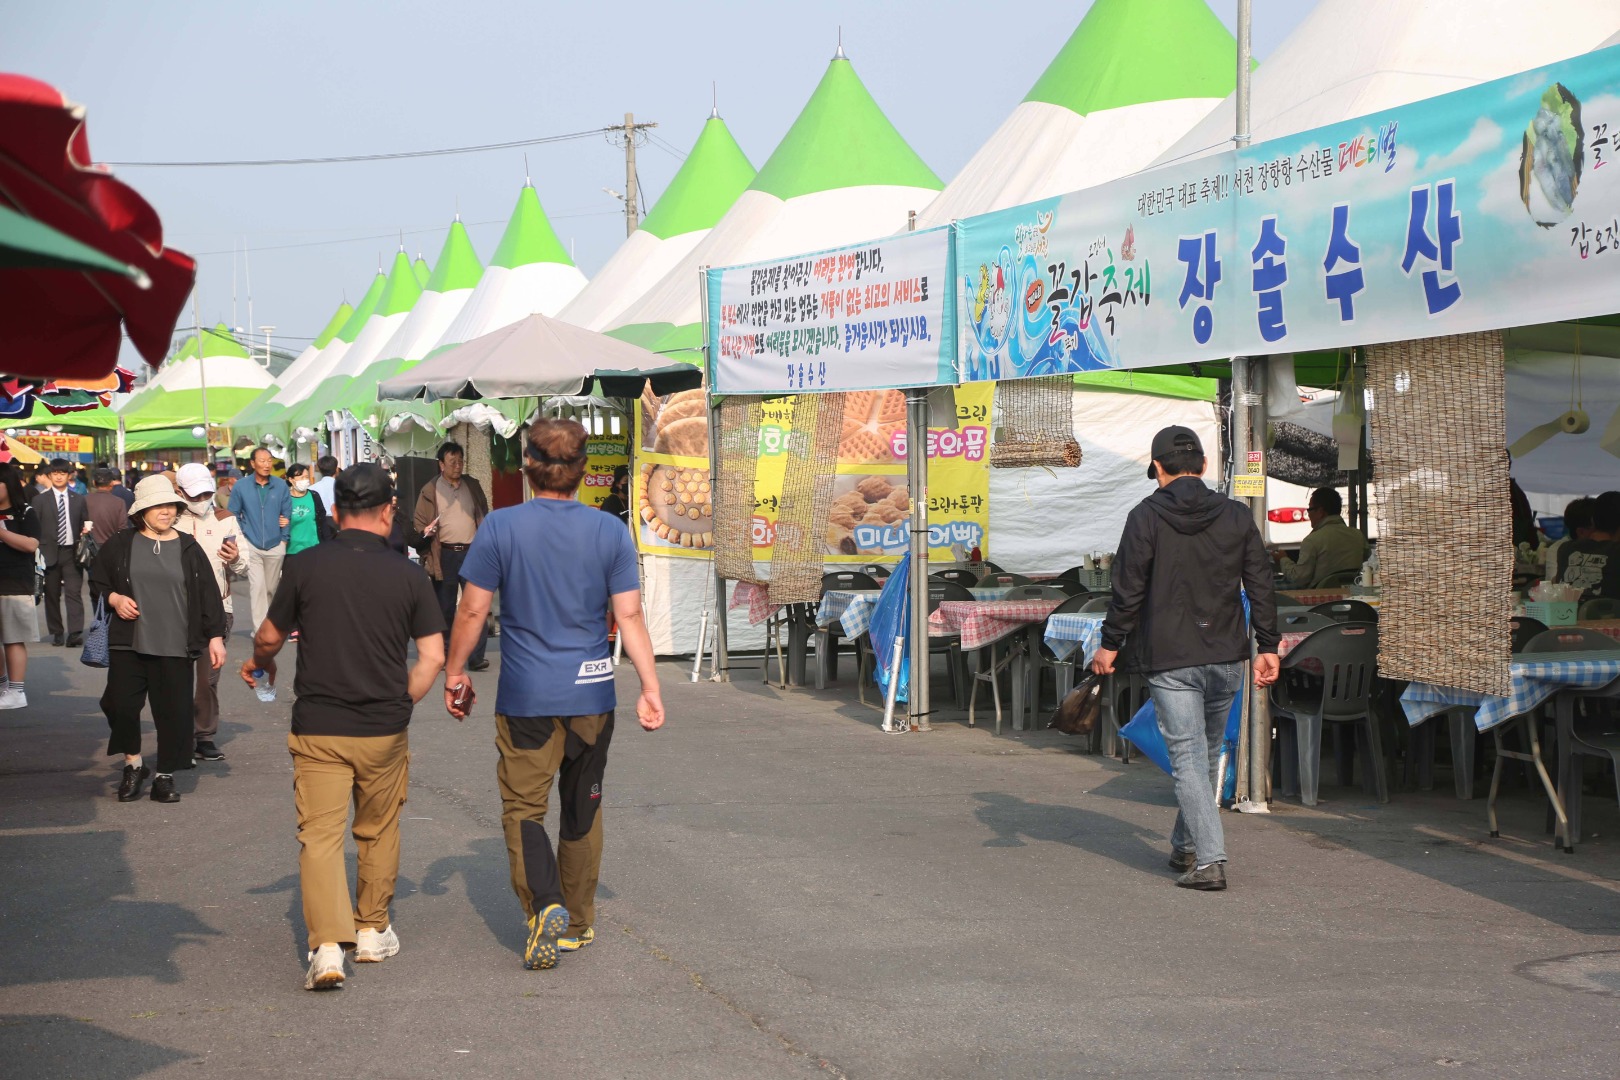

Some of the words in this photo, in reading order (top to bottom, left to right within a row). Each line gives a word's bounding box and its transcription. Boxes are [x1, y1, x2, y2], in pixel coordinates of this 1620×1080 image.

[1138, 187, 1175, 217] 대한민국
[1178, 182, 1197, 208] 대표
[1200, 174, 1229, 203] 축제!!
[1233, 166, 1254, 196] 서천
[1258, 157, 1293, 191] 장항항
[1296, 147, 1334, 182] 수산물
[1338, 121, 1398, 174] 페스티벌
[782, 261, 812, 290] 찾아주신
[814, 256, 836, 284] 여러분
[752, 300, 768, 327] 영업을
[770, 298, 782, 320] 하고
[784, 297, 797, 323] 있는
[799, 294, 818, 322] 업주는
[821, 289, 844, 319] 거품이
[846, 287, 861, 317] 없는
[864, 282, 891, 309] 최고의
[893, 276, 928, 305] 서비스로
[766, 330, 790, 357] 여러분을
[584, 662, 608, 673] EXR
